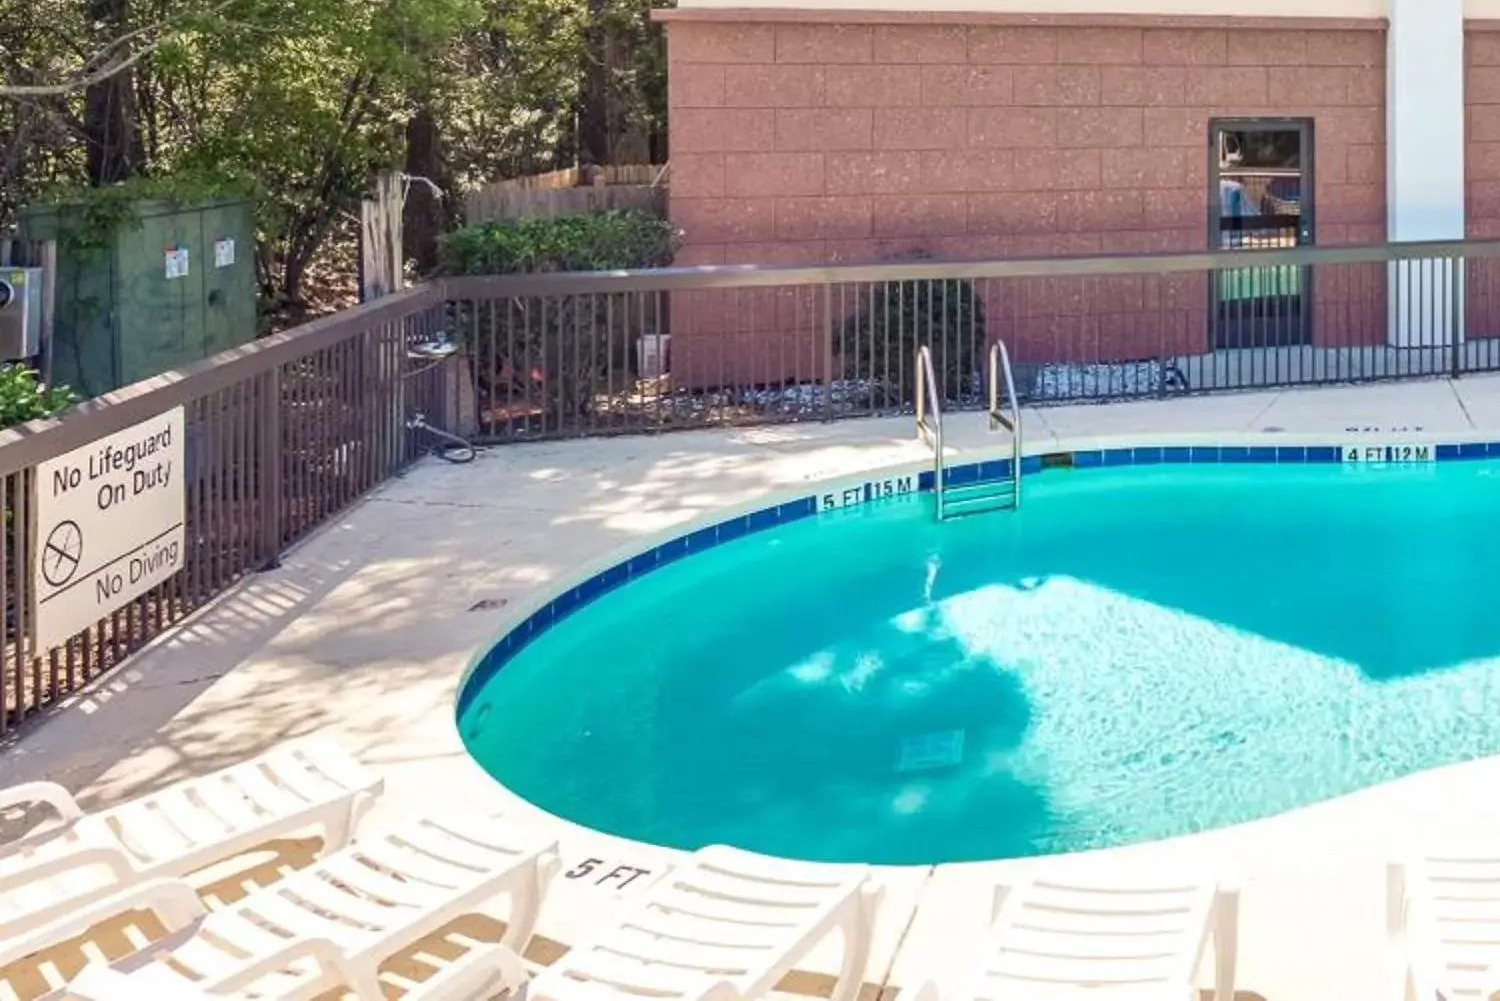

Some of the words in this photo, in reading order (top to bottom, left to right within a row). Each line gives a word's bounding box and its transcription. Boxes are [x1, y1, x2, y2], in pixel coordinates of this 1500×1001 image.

[53, 465, 81, 497] No
[89, 423, 172, 479] Lifeguard
[1347, 446, 1358, 461] 4
[1365, 446, 1382, 461] FT
[97, 482, 126, 511] On
[133, 461, 171, 496] Duty
[822, 493, 836, 511] 5
[843, 486, 863, 508] FT
[97, 575, 123, 604] No
[130, 539, 179, 584] Diving
[565, 857, 604, 879] 5
[594, 865, 651, 890] FT
